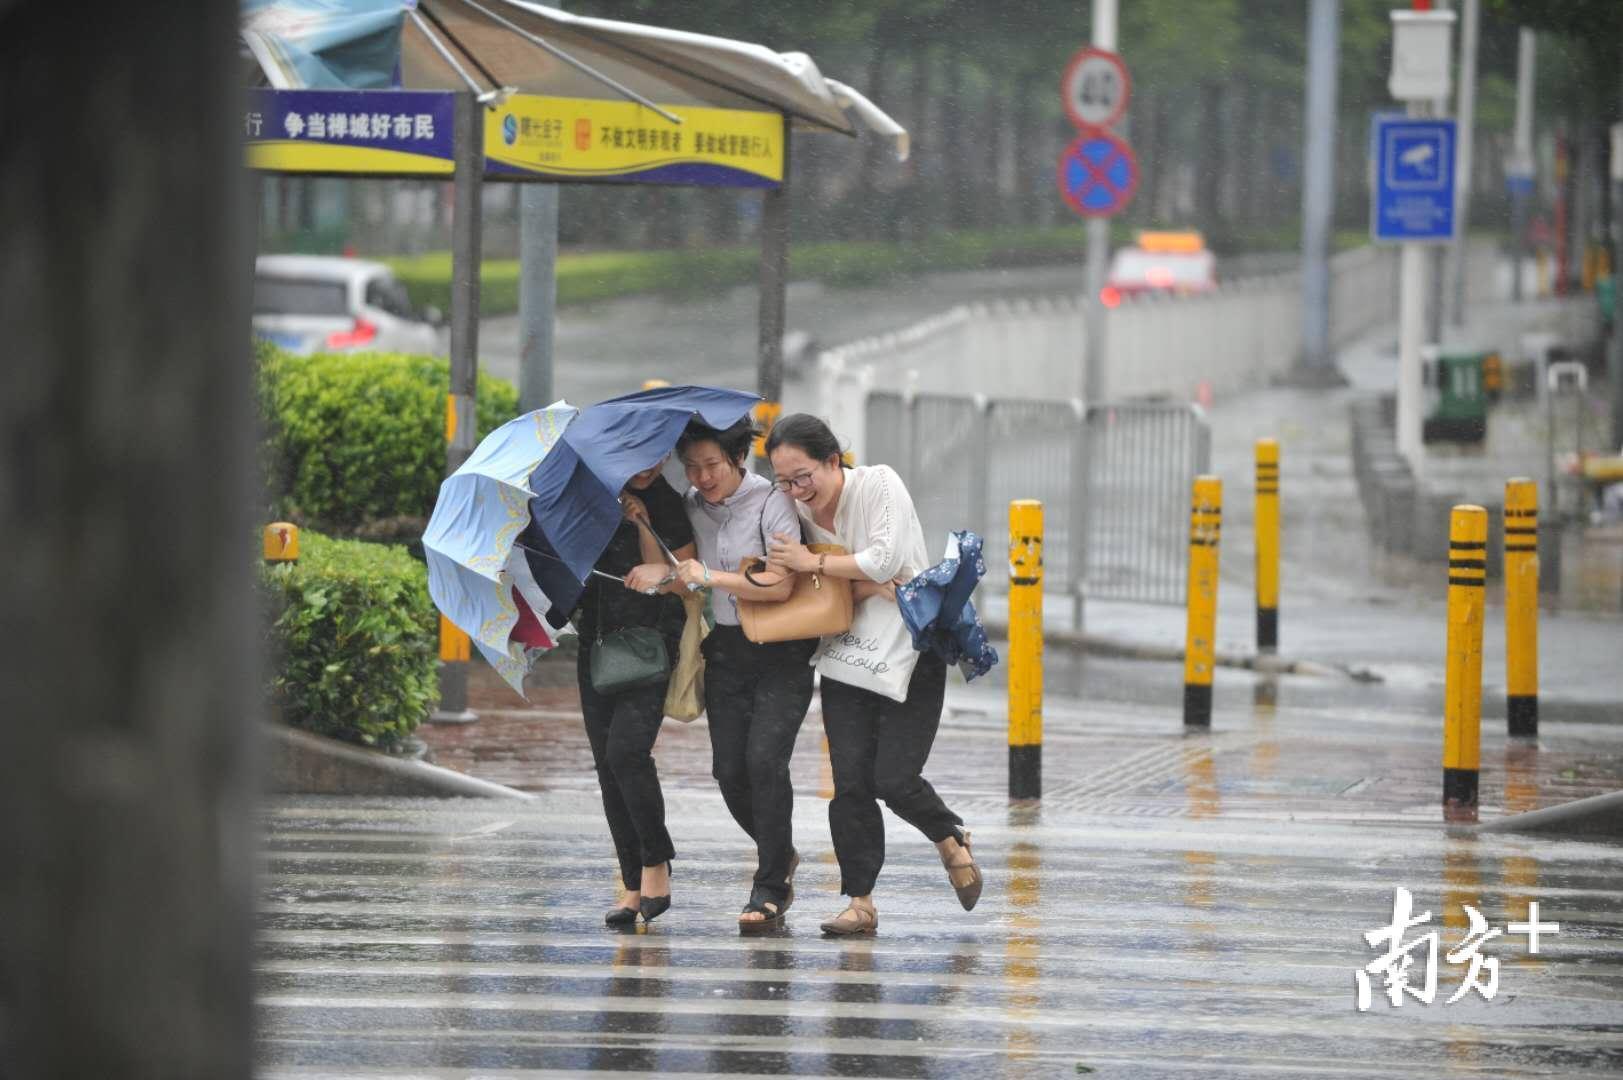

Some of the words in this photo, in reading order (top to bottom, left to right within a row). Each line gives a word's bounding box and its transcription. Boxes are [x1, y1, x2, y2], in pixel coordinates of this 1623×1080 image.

[284, 111, 435, 139] 争当禅城好市民
[600, 125, 682, 152] 不做文明旁观者
